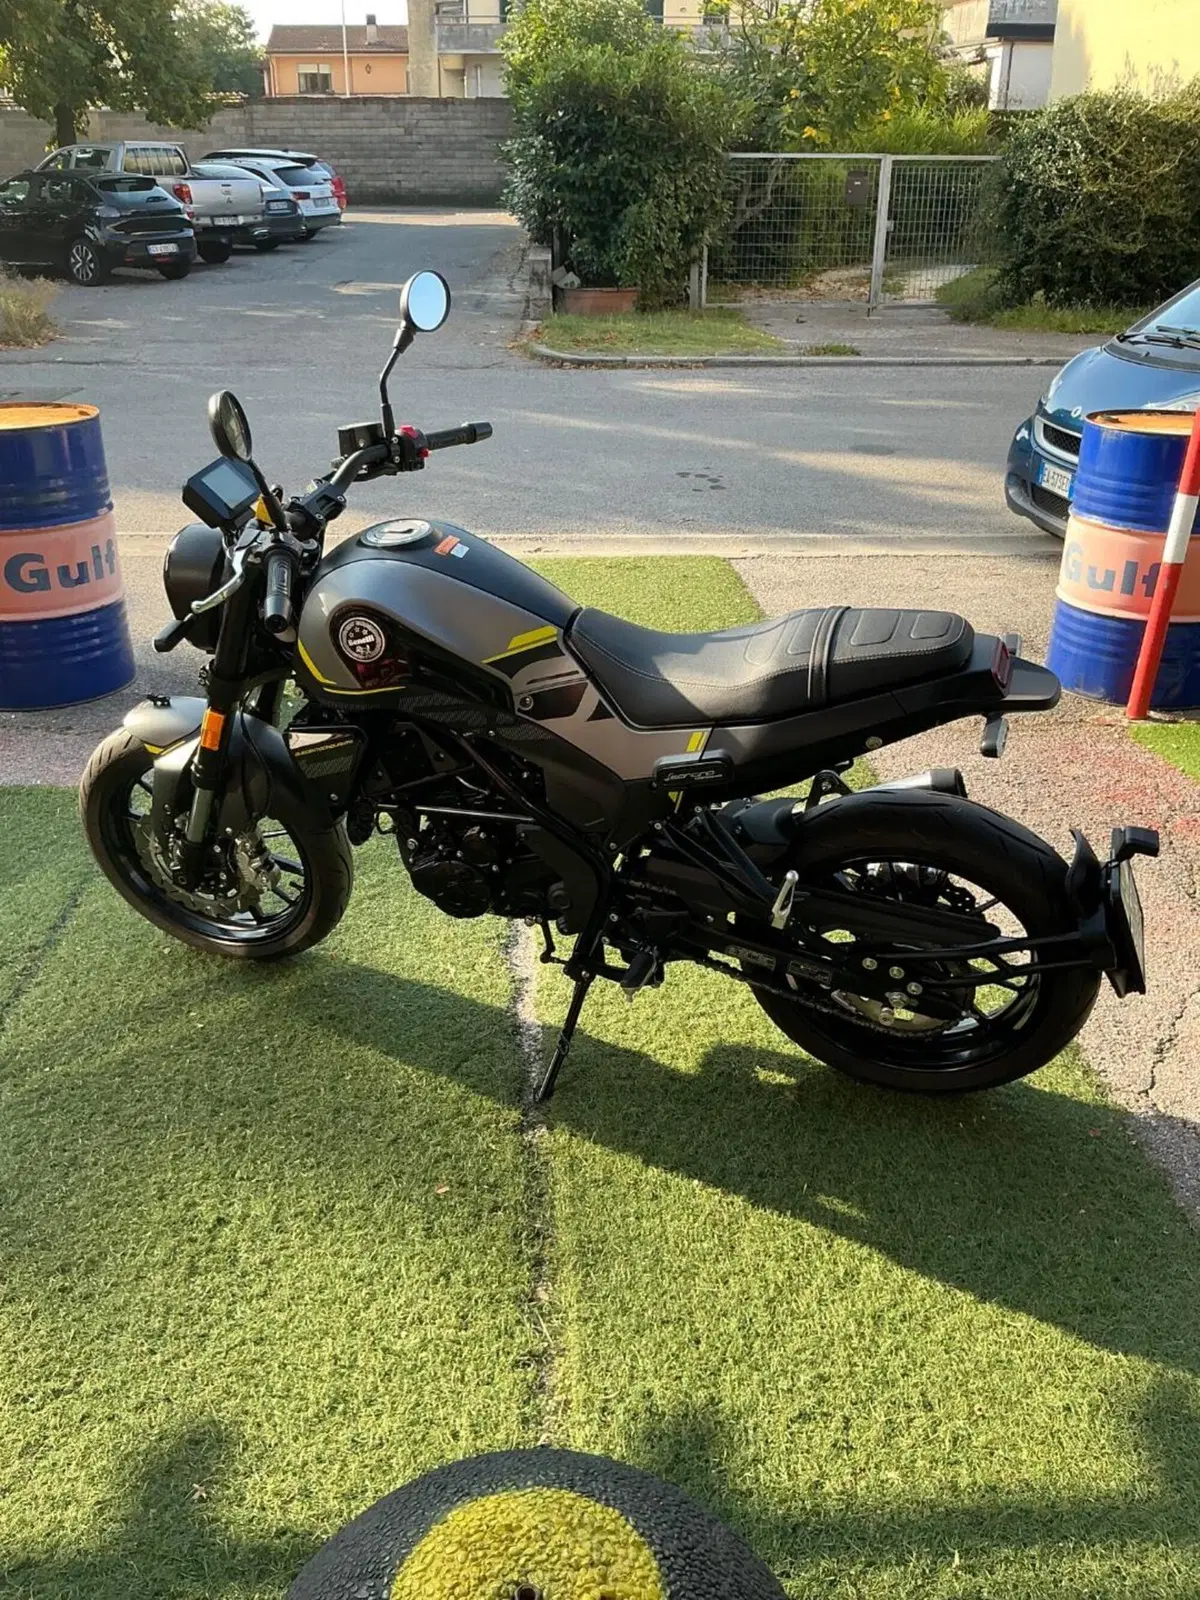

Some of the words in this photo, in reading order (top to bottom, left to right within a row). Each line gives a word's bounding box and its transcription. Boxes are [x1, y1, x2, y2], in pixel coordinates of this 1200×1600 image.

[4, 539, 115, 593] Gulf
[1065, 541, 1162, 598] Gulf
[347, 634, 375, 647] Benelli
